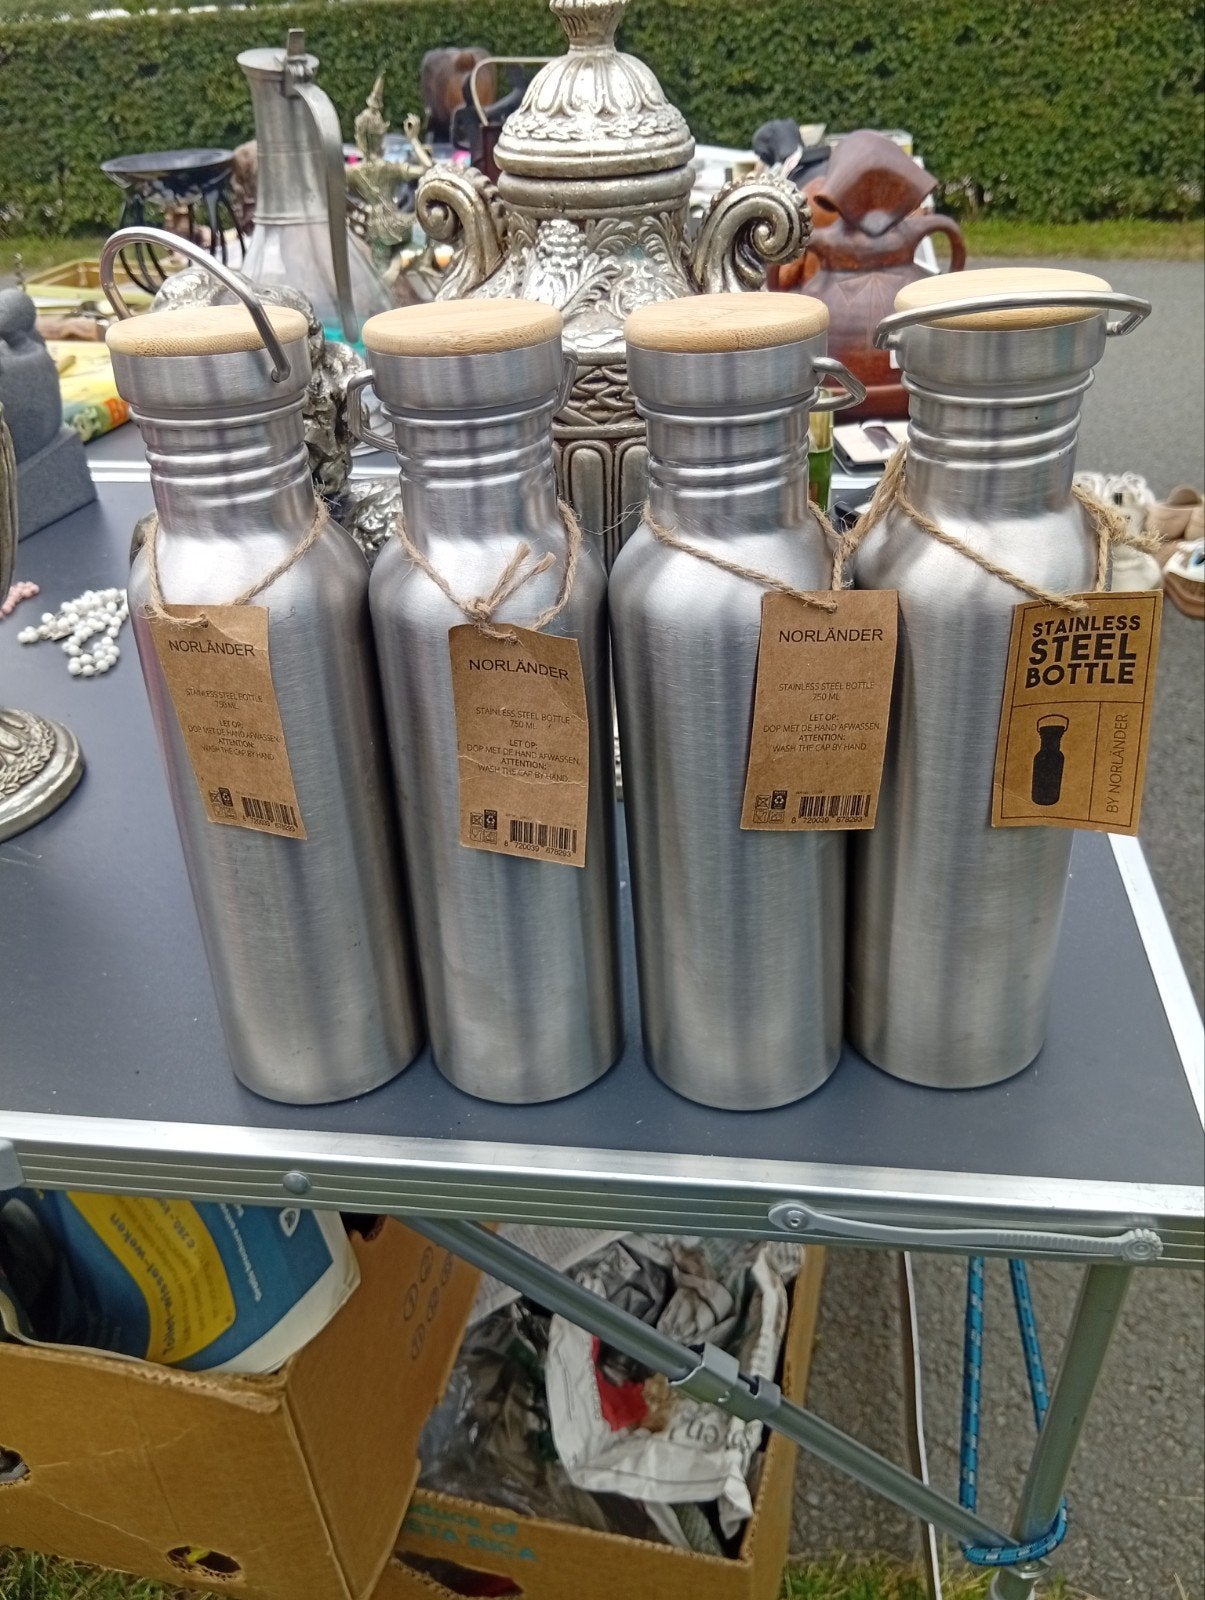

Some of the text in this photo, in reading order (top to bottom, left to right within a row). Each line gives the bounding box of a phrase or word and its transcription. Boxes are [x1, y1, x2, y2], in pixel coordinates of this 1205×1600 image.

[1032, 615, 1141, 638] STAINLESS
[778, 628, 883, 643] NORLÄNDER
[169, 639, 256, 657] NORLÄNDER
[1028, 633, 1137, 665] STEEL
[468, 658, 570, 681] NORLÄNDER
[1025, 662, 1135, 689] BOTTLE
[778, 681, 875, 692] STAINLESS STEEL BOTTLE
[812, 693, 840, 701] 750 ML
[475, 706, 571, 725] STAINLESS STEEL BOTTLE
[809, 713, 839, 722] LET OP:
[510, 719, 524, 728] 750
[763, 724, 781, 733] DOP
[782, 724, 800, 733] MET
[801, 724, 813, 732] DE
[814, 723, 837, 732] HAND
[509, 739, 538, 750] LET OP:
[798, 733, 846, 742] ATTENTION:
[466, 743, 484, 752] DOP
[485, 746, 501, 755] MET
[502, 748, 514, 756] DE
[515, 750, 537, 759] HAND
[772, 744, 796, 753] WASH
[798, 744, 814, 752] THE
[815, 743, 831, 752] CAP
[832, 743, 842, 751] BY
[477, 764, 500, 774] WASH
[501, 757, 548, 770] ATTENTION:
[1106, 714, 1129, 815] BY NORLÄNDER
[503, 839, 572, 858] 8 720039 678293
